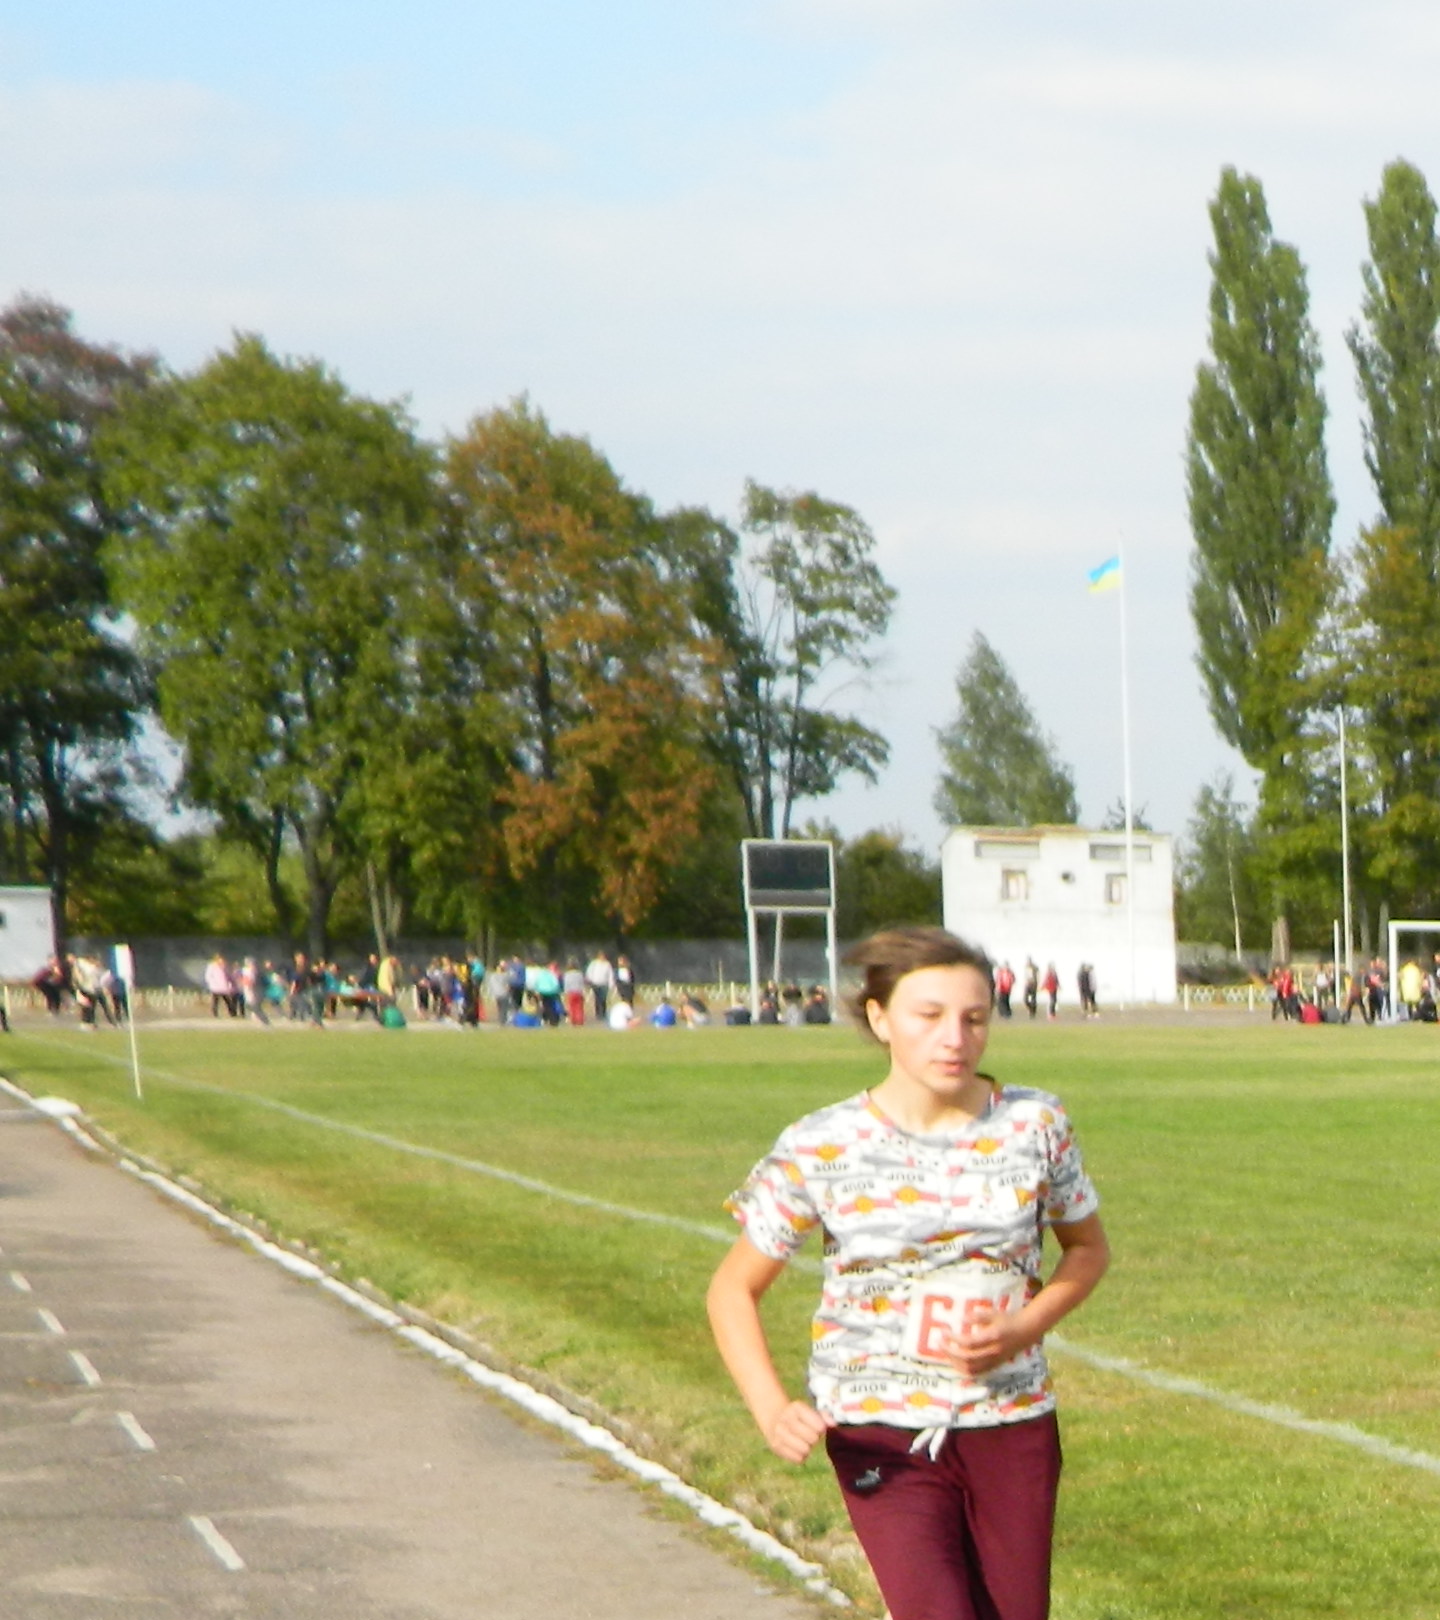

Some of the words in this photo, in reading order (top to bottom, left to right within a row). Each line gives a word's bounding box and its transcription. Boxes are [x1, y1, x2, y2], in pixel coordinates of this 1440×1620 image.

[971, 1154, 1008, 1166] SOUP
[813, 1161, 850, 1173] SOUP
[887, 1171, 925, 1183] SOUP
[841, 1179, 875, 1194] SOUP
[902, 1375, 939, 1388] SOUP
[849, 1382, 888, 1394] SOUP
